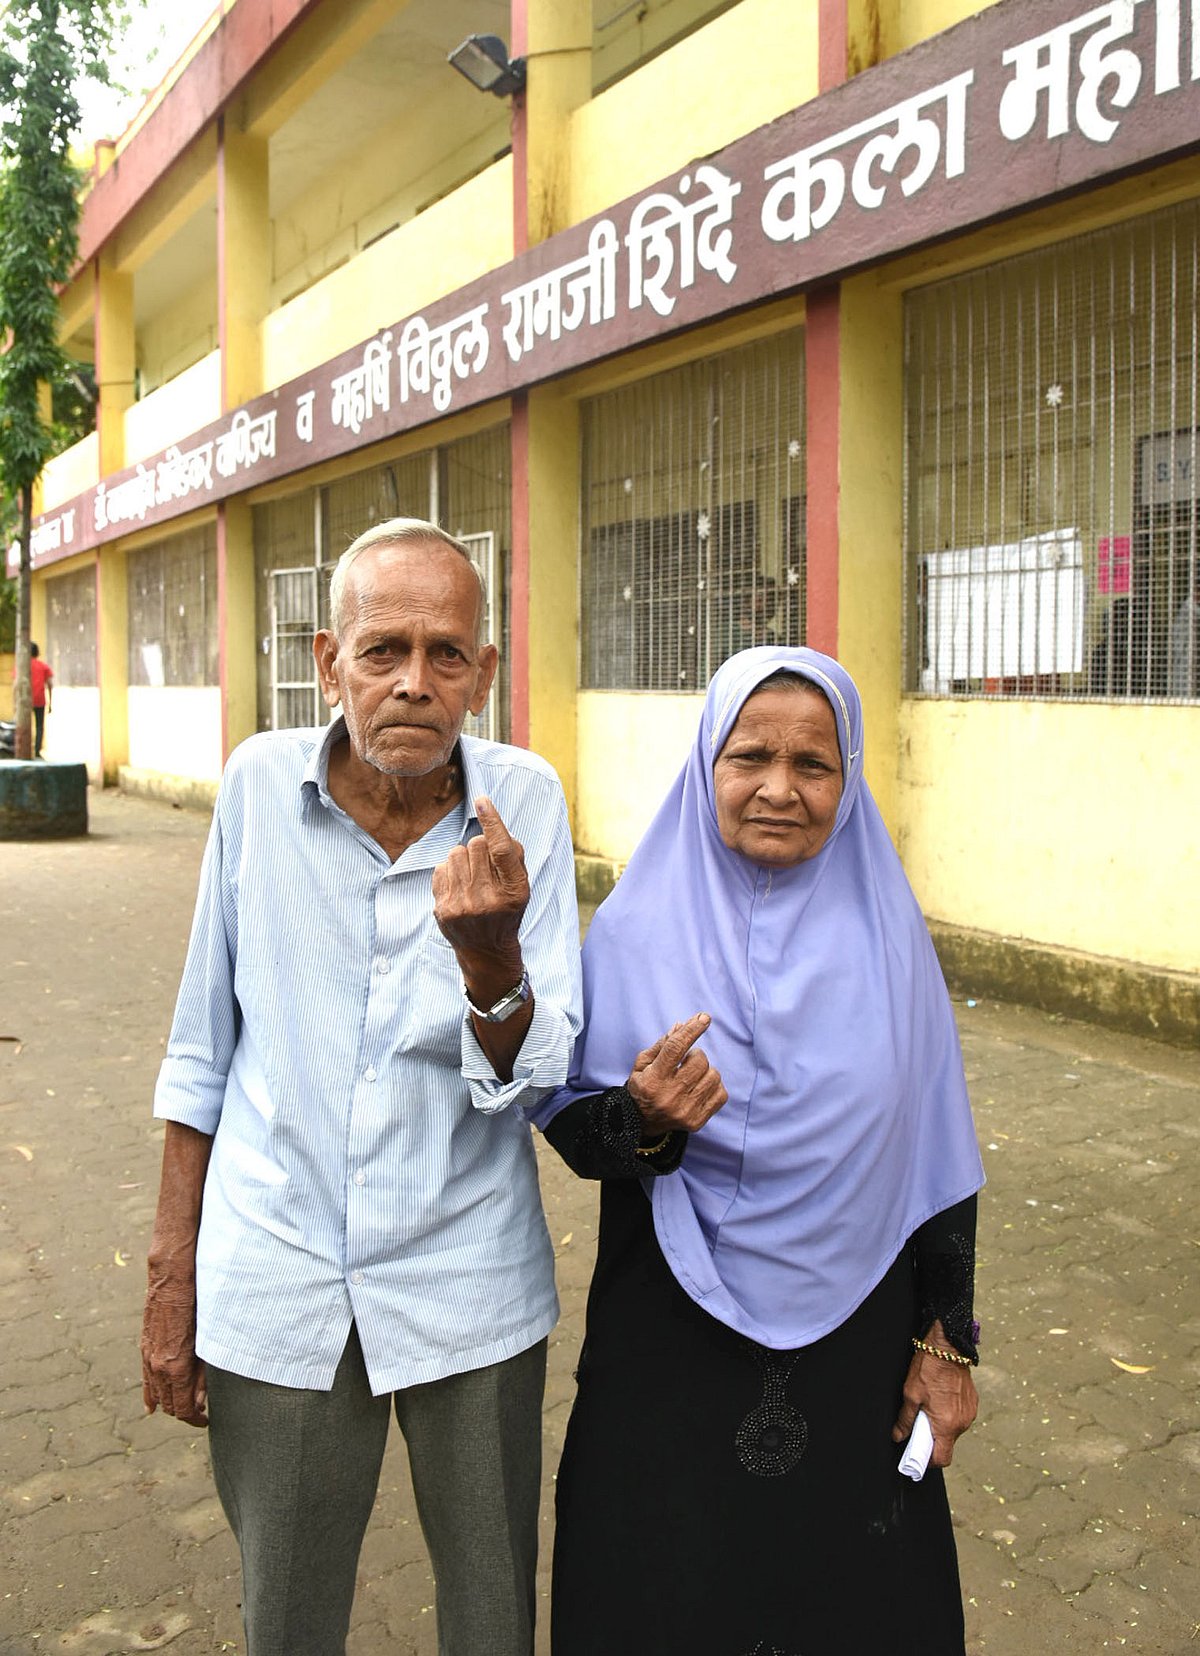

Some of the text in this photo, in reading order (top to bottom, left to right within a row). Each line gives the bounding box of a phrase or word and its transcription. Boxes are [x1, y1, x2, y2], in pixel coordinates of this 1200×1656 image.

[216, 410, 277, 478] वाणिज्य
[297, 391, 315, 442] व
[331, 331, 393, 434] महर्षि
[397, 303, 489, 411] विठ्ठल
[501, 220, 618, 361] रामजी
[625, 166, 742, 315] शिंदे
[762, 70, 973, 242] कला
